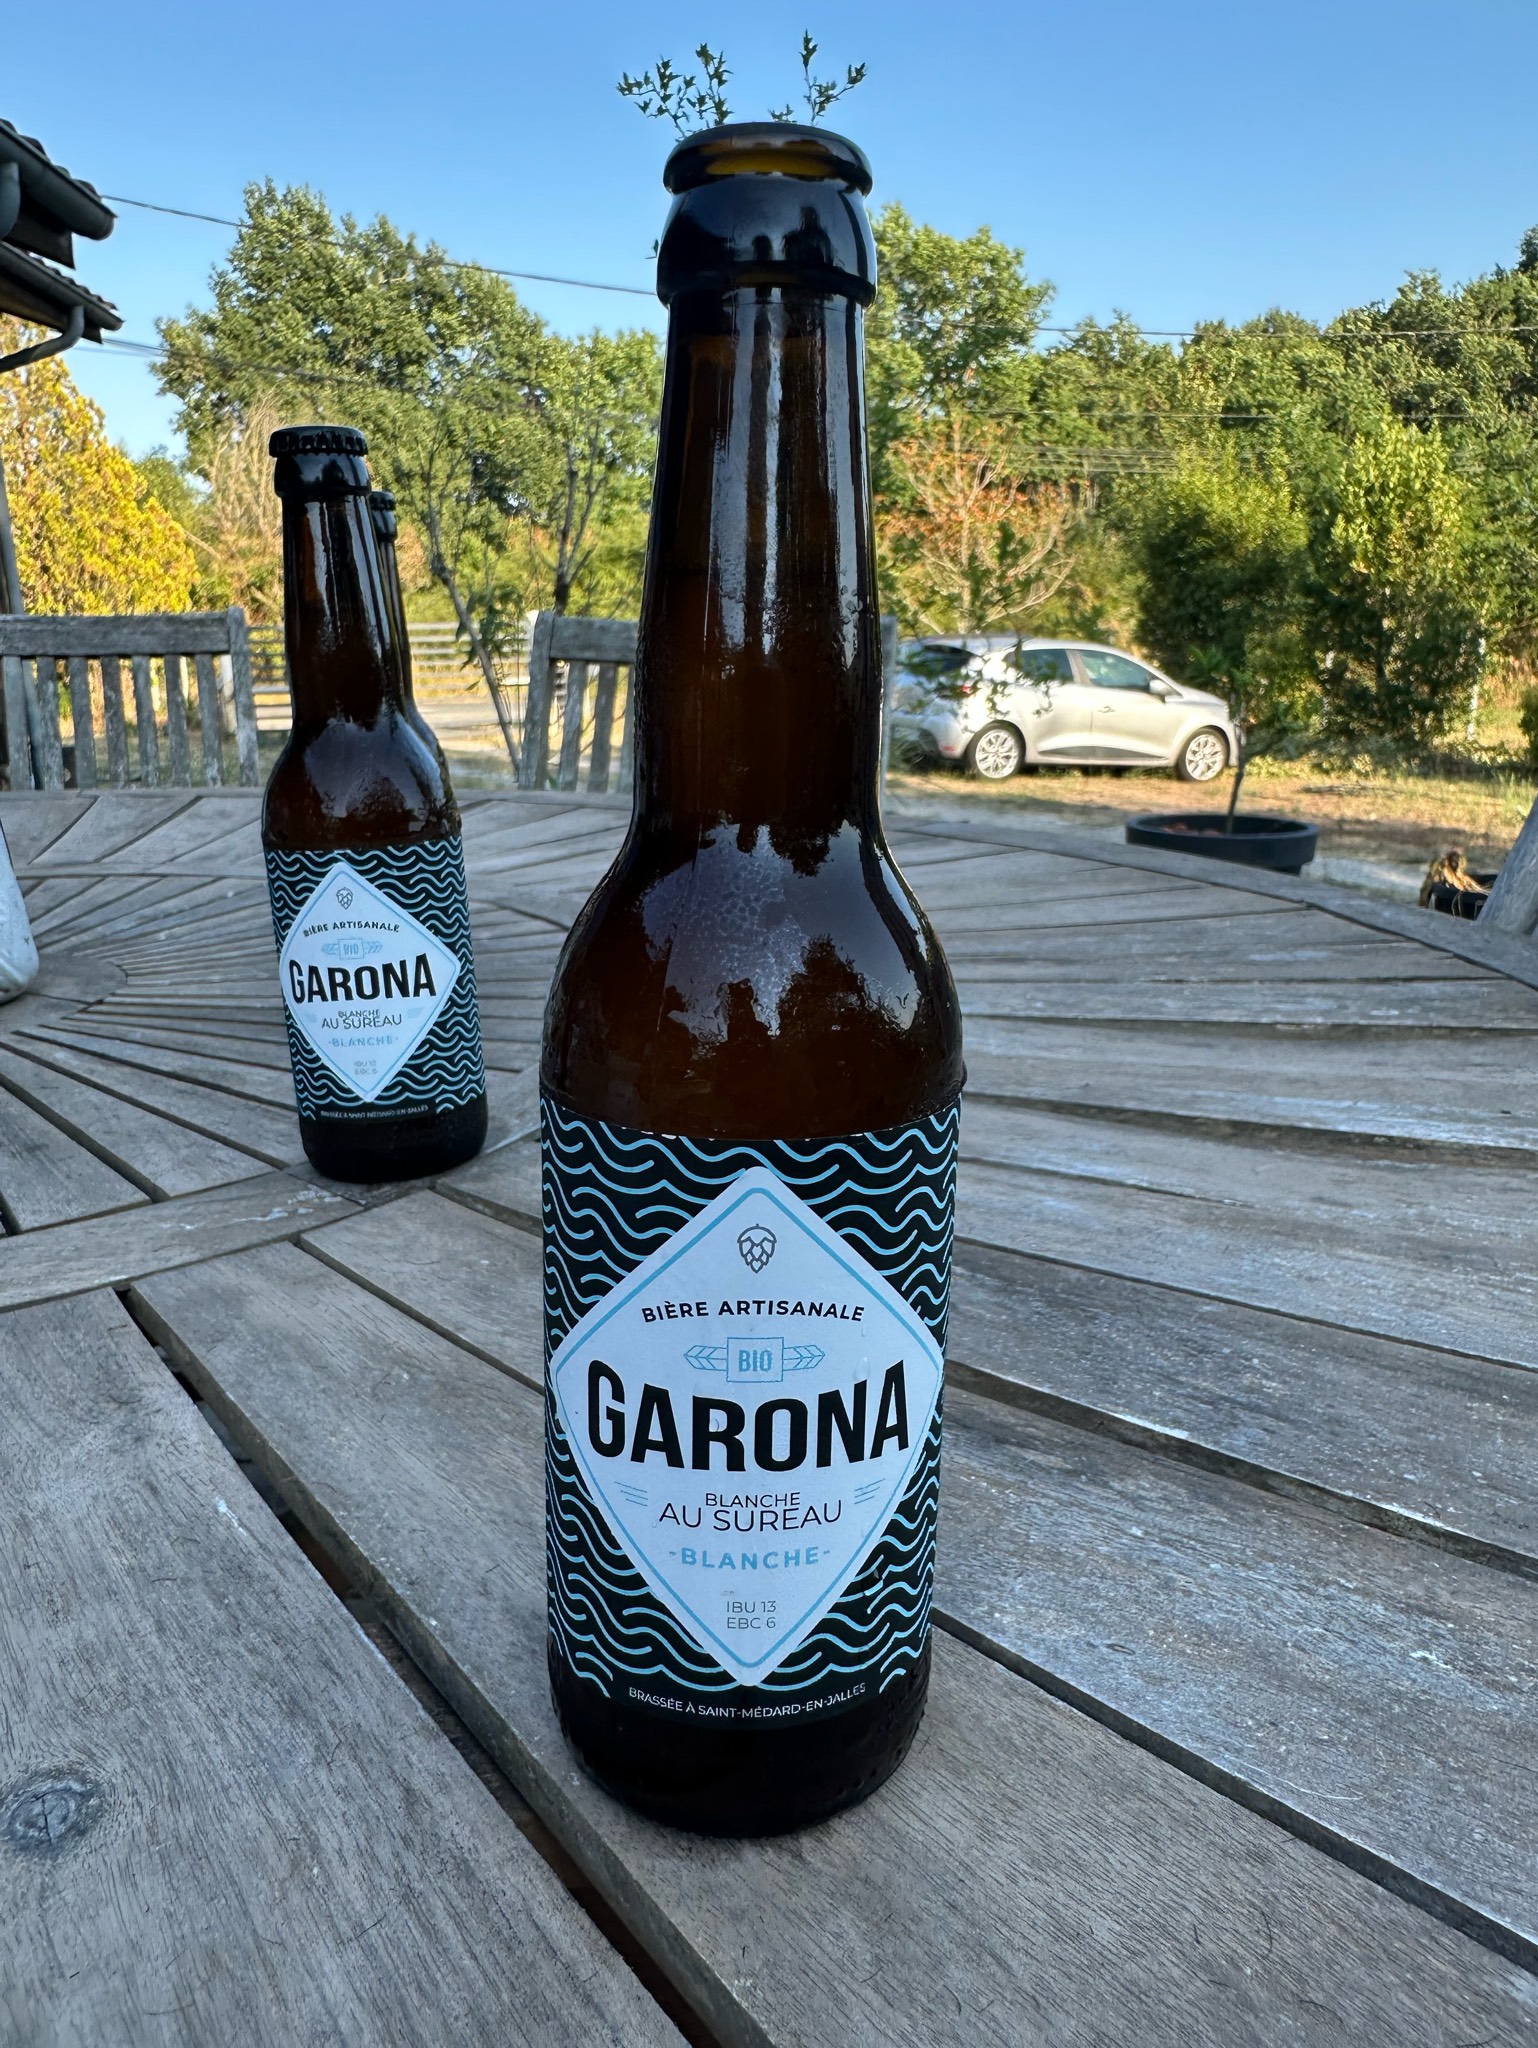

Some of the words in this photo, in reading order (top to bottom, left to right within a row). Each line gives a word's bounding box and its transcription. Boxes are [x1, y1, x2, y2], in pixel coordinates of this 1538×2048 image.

[289, 953, 437, 1005] GARONA
[321, 1017, 339, 1030] AU
[343, 1014, 402, 1029] SUREAU
[641, 1299, 709, 1323] BIÈRE
[718, 1300, 865, 1323] ARTISANALE
[738, 1348, 773, 1373] BIO
[587, 1359, 910, 1472] GARONA
[705, 1491, 801, 1508] BLANCHE
[659, 1502, 702, 1528] AU
[713, 1499, 842, 1532] SUREAU
[726, 1600, 756, 1614] IBU
[760, 1600, 777, 1613] 13
[726, 1616, 762, 1629] EBC
[766, 1616, 777, 1629] 6
[628, 1686, 684, 1712] BRASSÉE
[685, 1699, 696, 1715] À
[698, 1682, 867, 1719] SAINT-MÉDARD-EN-JALLES
